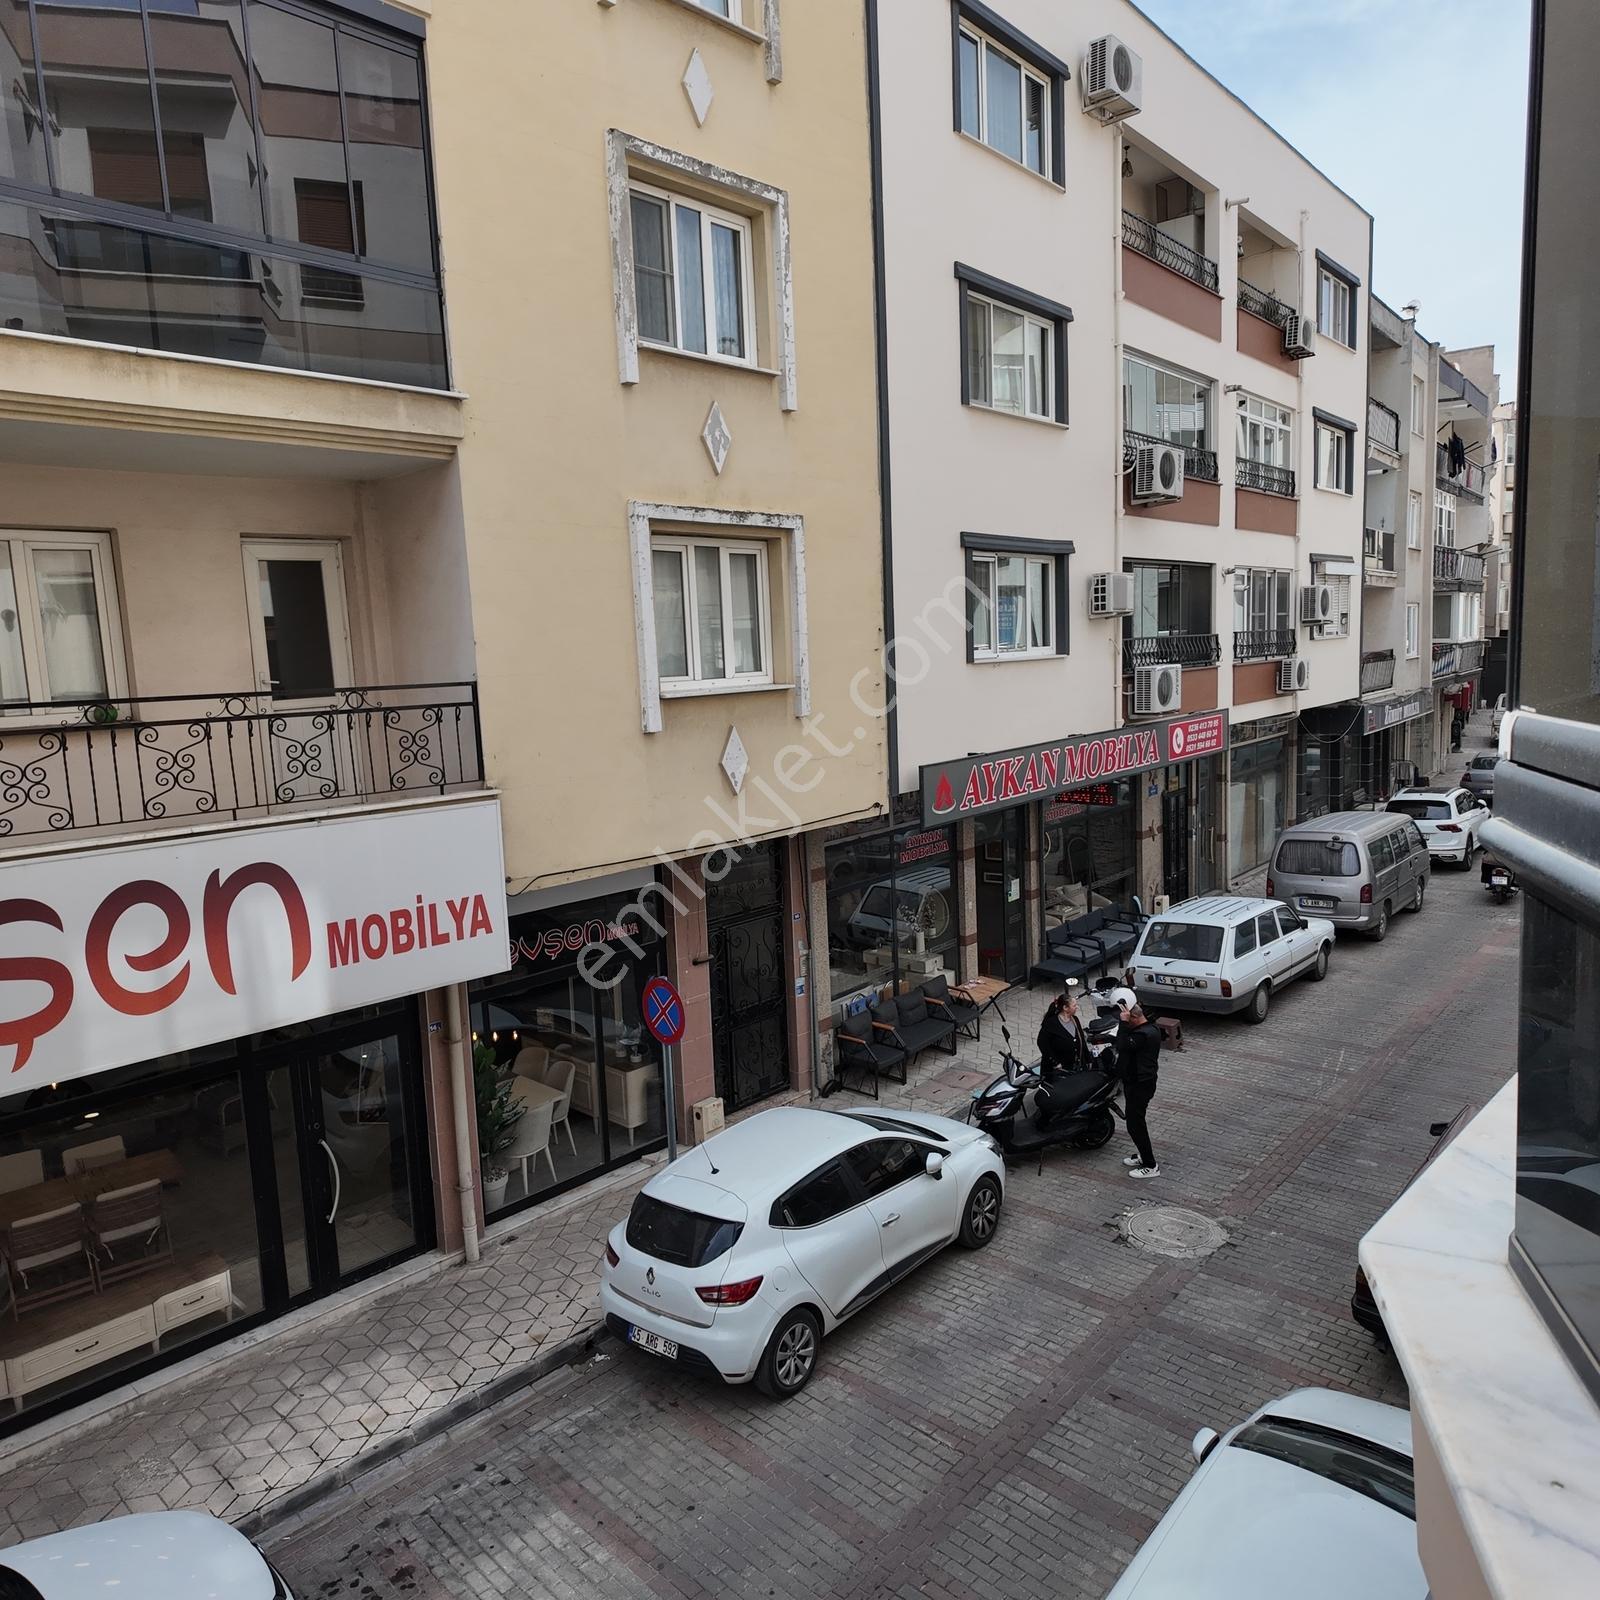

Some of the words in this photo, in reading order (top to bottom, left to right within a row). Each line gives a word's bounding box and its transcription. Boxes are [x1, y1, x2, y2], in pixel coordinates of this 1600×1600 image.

[960, 749, 1060, 811] AYKAN
[905, 829, 943, 849] AYKAN
[326, 894, 494, 969] MOBİLYA
[641, 1286, 661, 1298] CLIO
[632, 1327, 642, 1342] 45
[645, 1333, 659, 1349] ARG
[662, 1340, 678, 1357] 592
